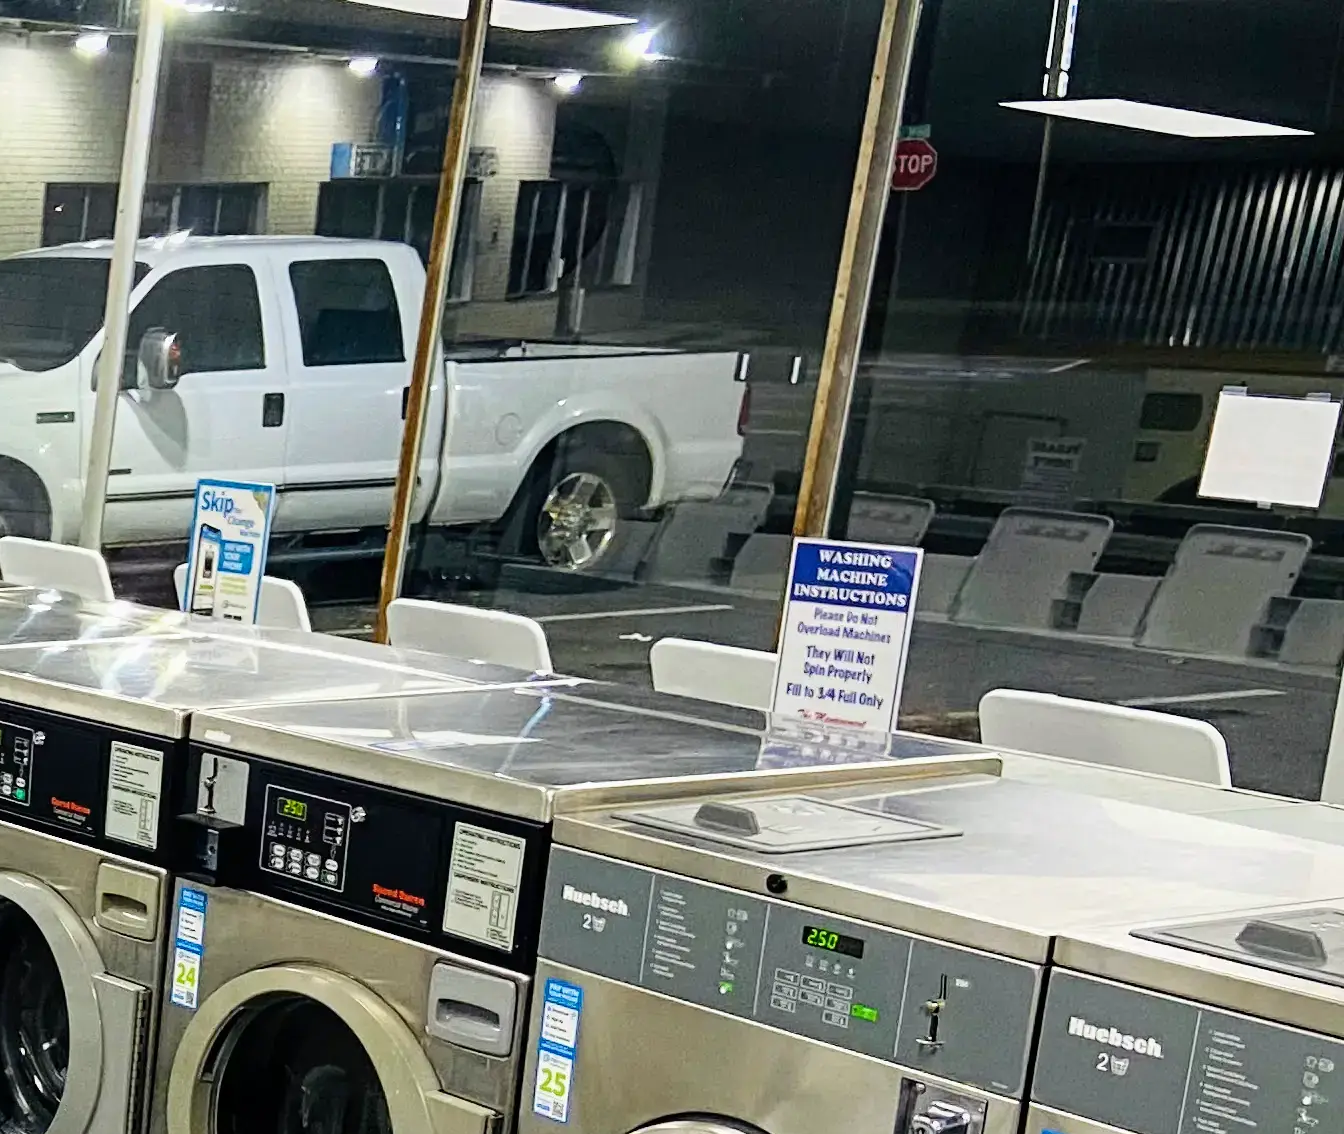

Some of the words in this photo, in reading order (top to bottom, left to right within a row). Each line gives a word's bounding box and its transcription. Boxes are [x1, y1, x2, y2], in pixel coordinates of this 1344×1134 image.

[897, 154, 933, 174] TOP
[201, 491, 234, 518] Skip
[819, 549, 892, 569] WASHING
[817, 567, 889, 587] MACHINE
[794, 583, 907, 608] INSTRUCTIONS
[814, 607, 844, 621] Please
[847, 611, 858, 624] Do
[860, 613, 878, 626] Not
[797, 621, 841, 637] Overload
[842, 626, 891, 644] Machines
[806, 645, 831, 662] They
[834, 648, 854, 663] Will
[856, 651, 875, 665] Not
[804, 661, 825, 677] Spin
[786, 682, 801, 697] Fill
[804, 685, 814, 698] to
[838, 689, 857, 704] Full
[859, 692, 884, 710] Only
[562, 884, 628, 916] Huebsch
[582, 913, 592, 929] 2
[176, 962, 196, 988] 24
[1068, 1015, 1161, 1057] Huebsch
[1096, 1052, 1108, 1072] 2
[539, 1068, 566, 1097] 25
